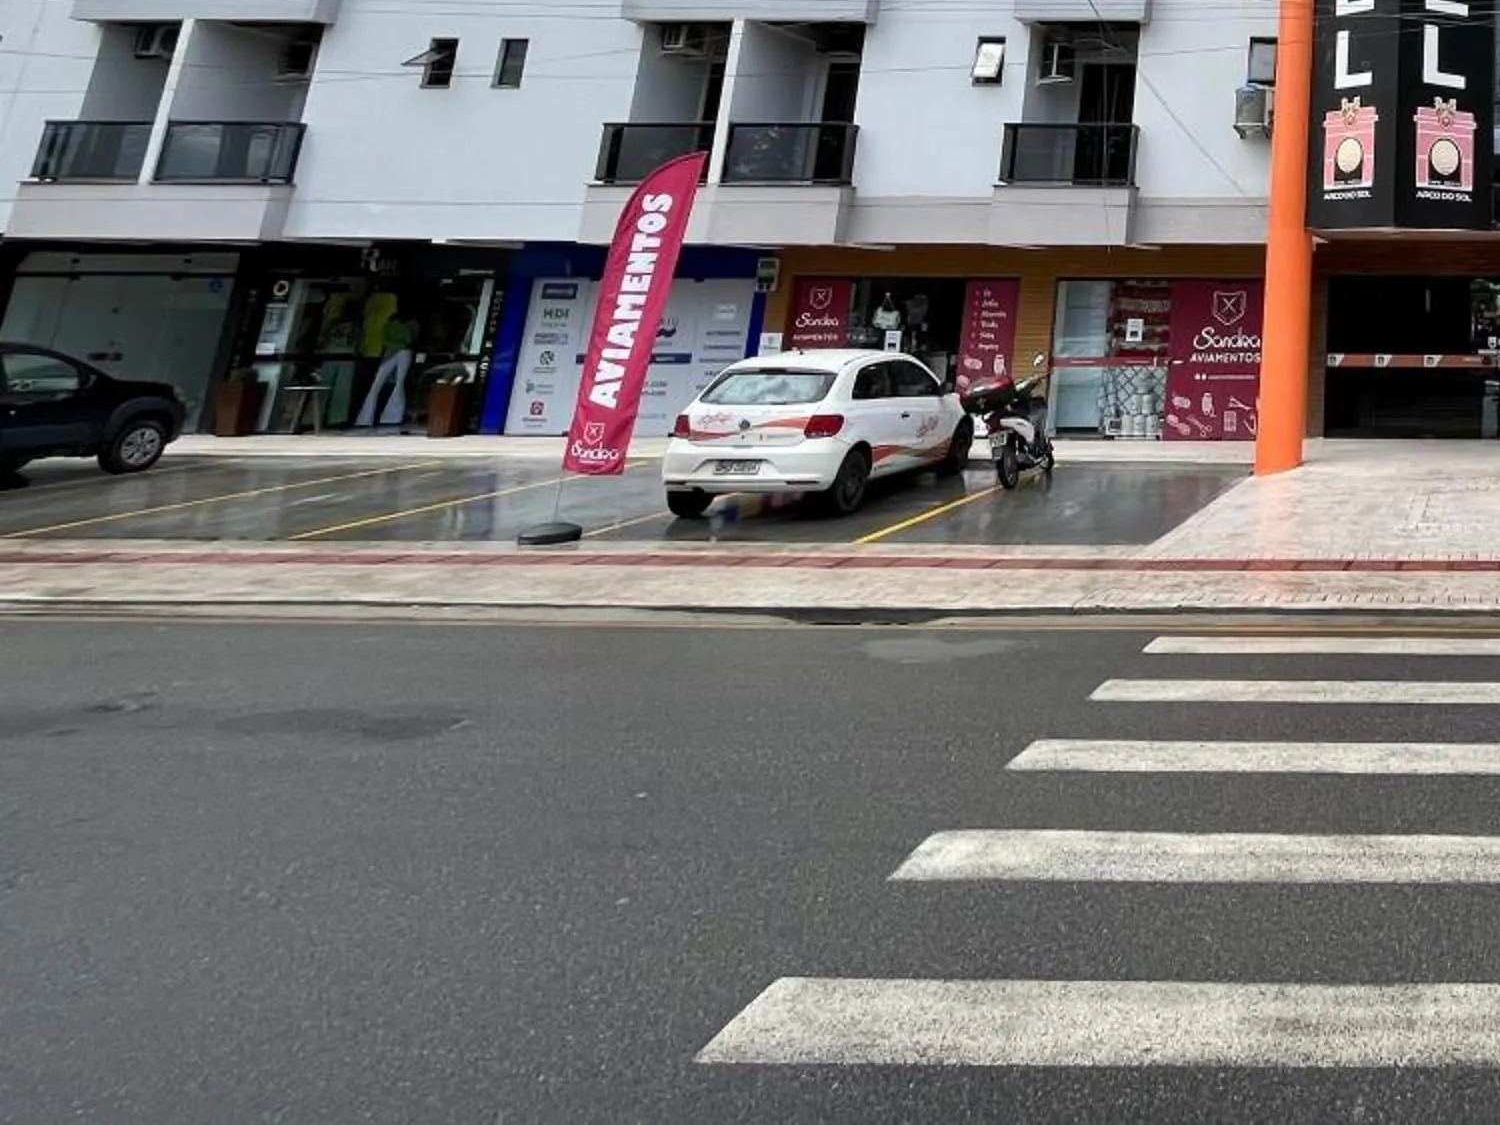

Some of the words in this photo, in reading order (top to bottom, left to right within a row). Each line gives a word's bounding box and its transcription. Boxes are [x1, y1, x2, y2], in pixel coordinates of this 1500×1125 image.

[1416, 191, 1439, 200] ARCO
[1440, 192, 1454, 200] DO
[1455, 193, 1472, 202] SOL
[589, 193, 673, 408] AVIAMENTOS
[795, 312, 839, 328] Sandra
[1193, 326, 1261, 350] Sandra
[1190, 352, 1262, 364] AVIAMENTOS
